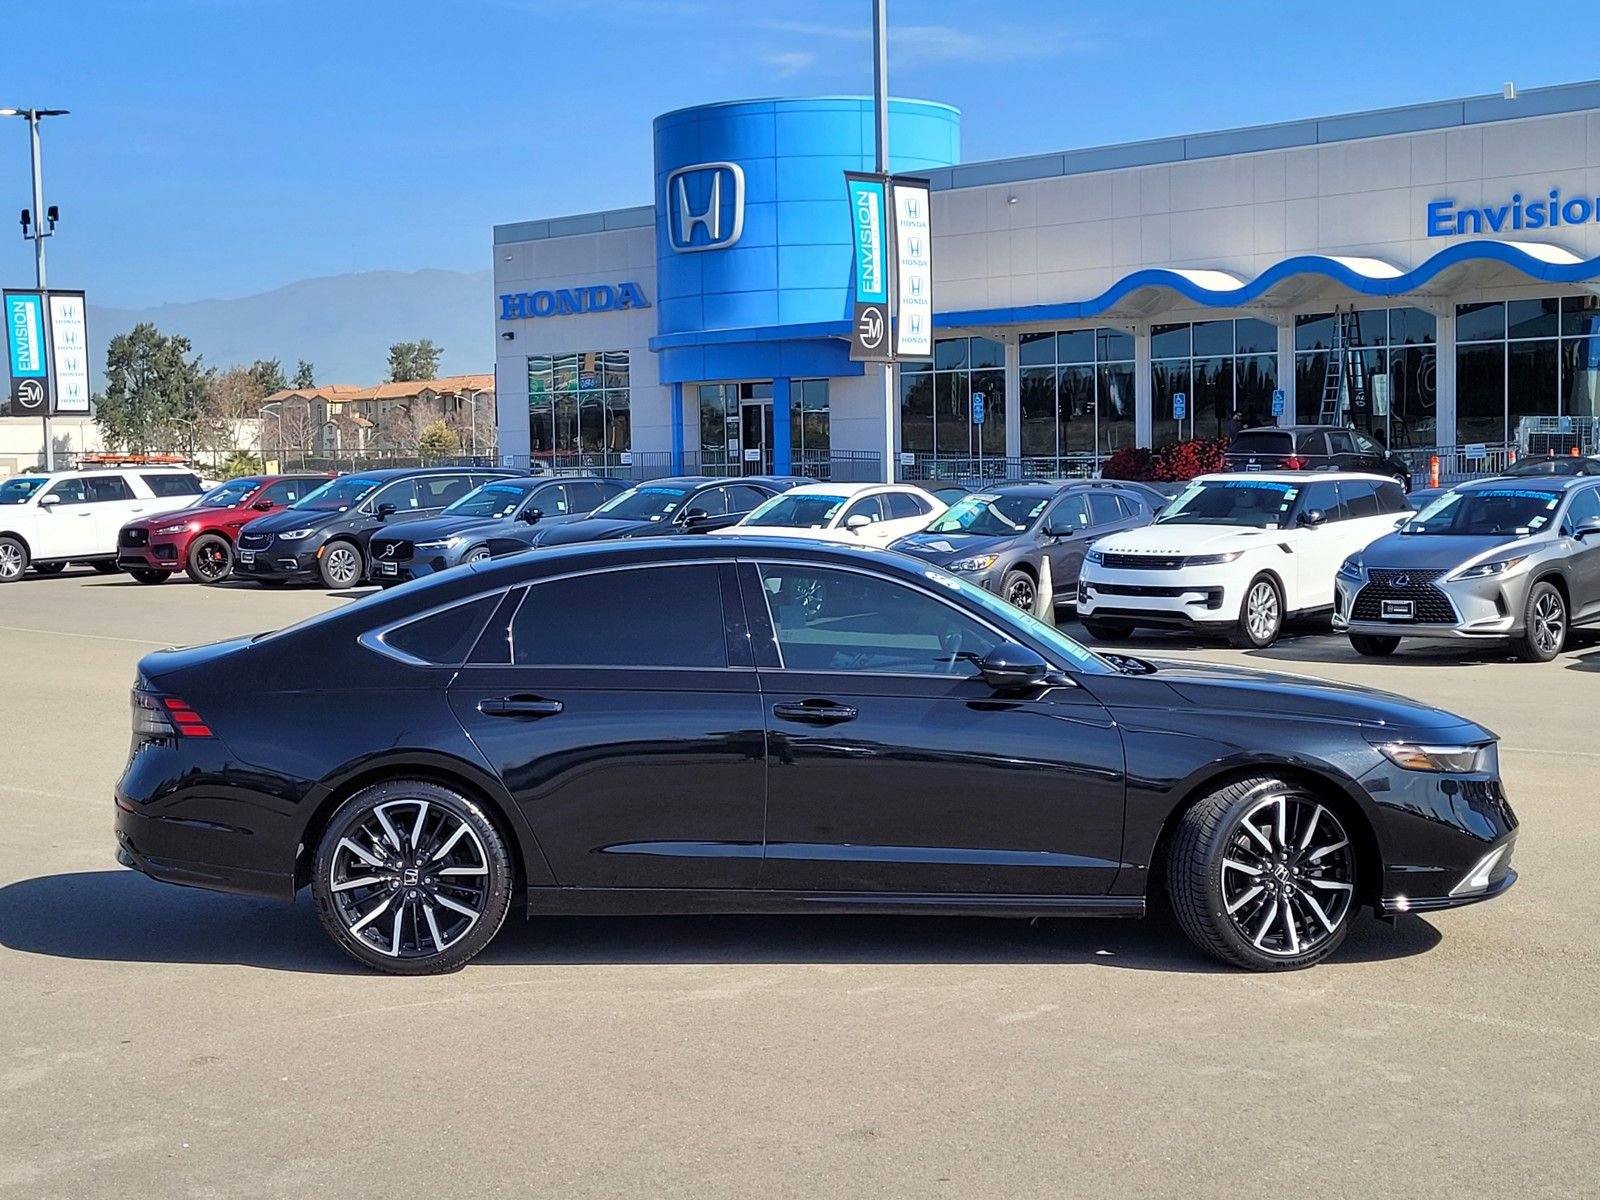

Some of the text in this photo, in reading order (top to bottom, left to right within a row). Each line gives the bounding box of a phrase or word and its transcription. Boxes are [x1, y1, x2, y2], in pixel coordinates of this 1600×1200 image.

[900, 220, 927, 228] HONDA
[1427, 188, 1600, 237] Envisio
[856, 191, 874, 293] ENVISION
[902, 259, 928, 267] HONDA
[499, 282, 652, 321] HONDA
[902, 297, 928, 305] HONDA
[13, 301, 31, 371] ENVISION
[901, 336, 927, 345] HONDA
